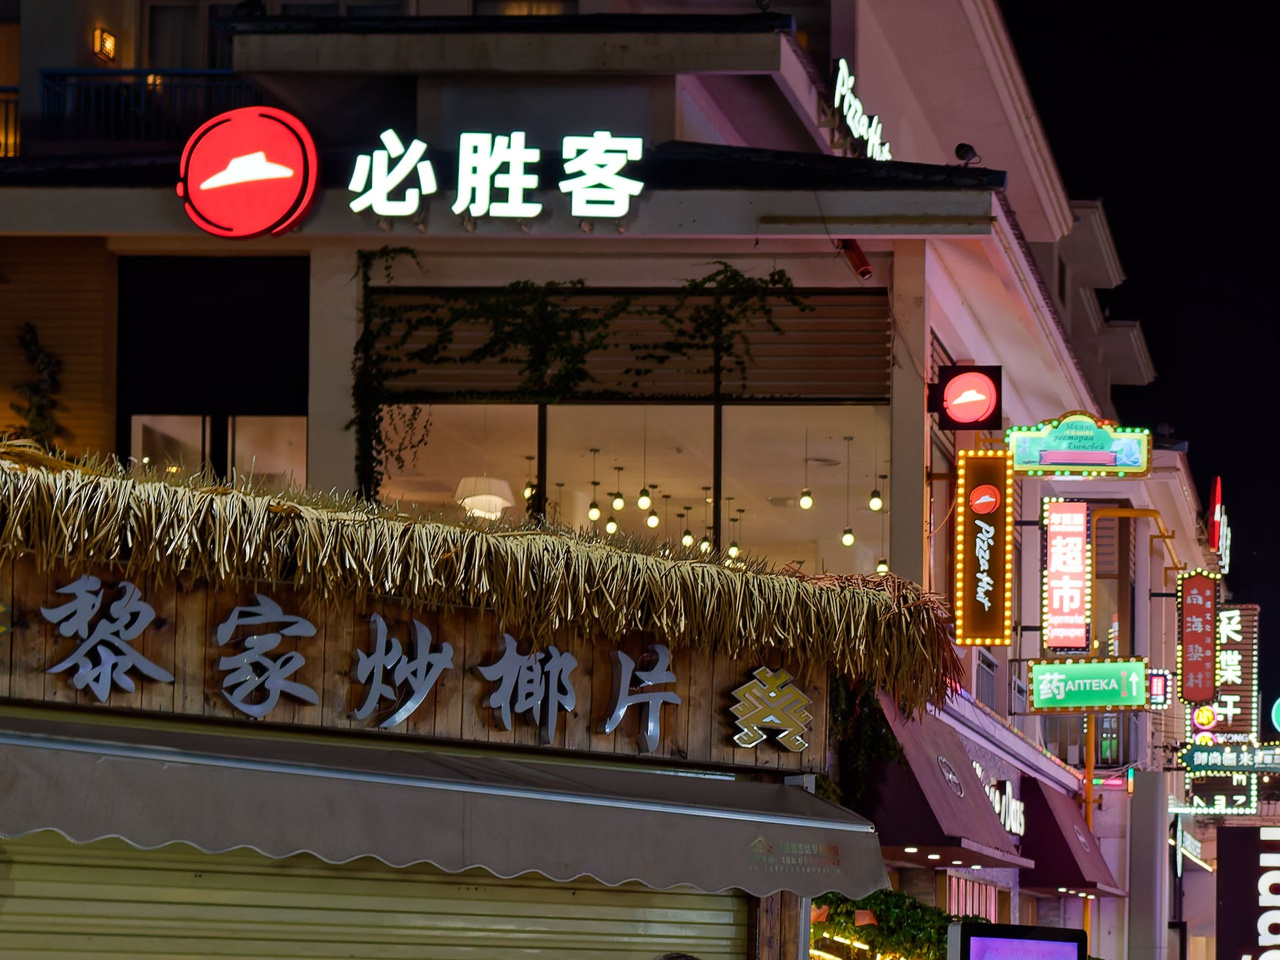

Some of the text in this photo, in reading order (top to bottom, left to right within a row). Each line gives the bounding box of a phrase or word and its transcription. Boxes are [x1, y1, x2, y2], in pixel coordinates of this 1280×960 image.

[349, 128, 646, 219] 必胜客
[974, 519, 996, 612] Pizza Hut
[1049, 535, 1084, 613] 超市
[40, 574, 683, 755] 黎家炒椰片
[1037, 671, 1119, 700] 药 АПТЕКА
